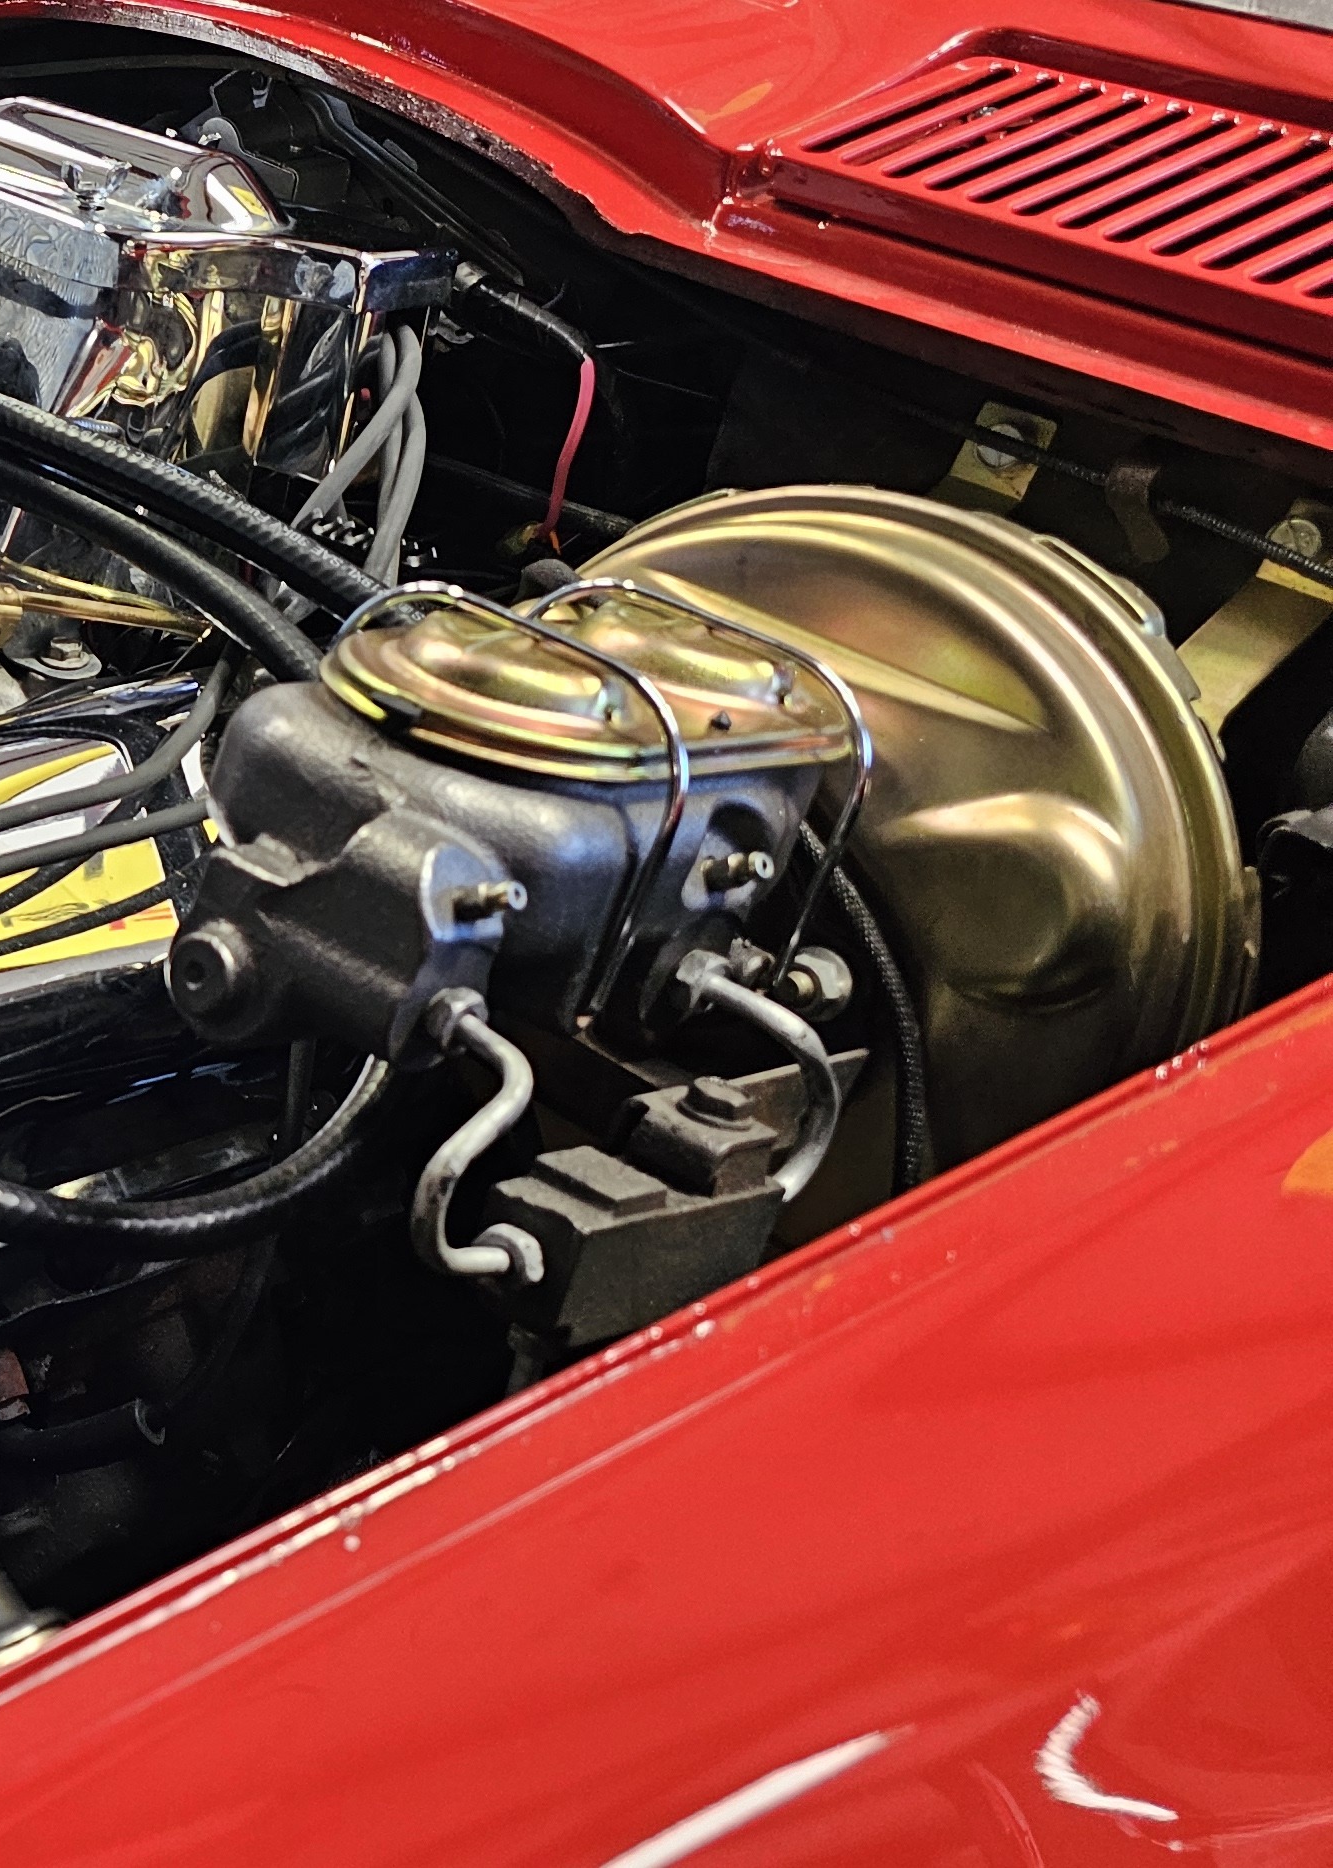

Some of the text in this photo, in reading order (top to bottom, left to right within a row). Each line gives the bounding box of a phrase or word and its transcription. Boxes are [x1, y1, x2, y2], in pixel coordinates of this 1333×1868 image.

[200, 481, 235, 505] Line
[233, 499, 271, 524] Fuel
[309, 542, 344, 569] SAE
